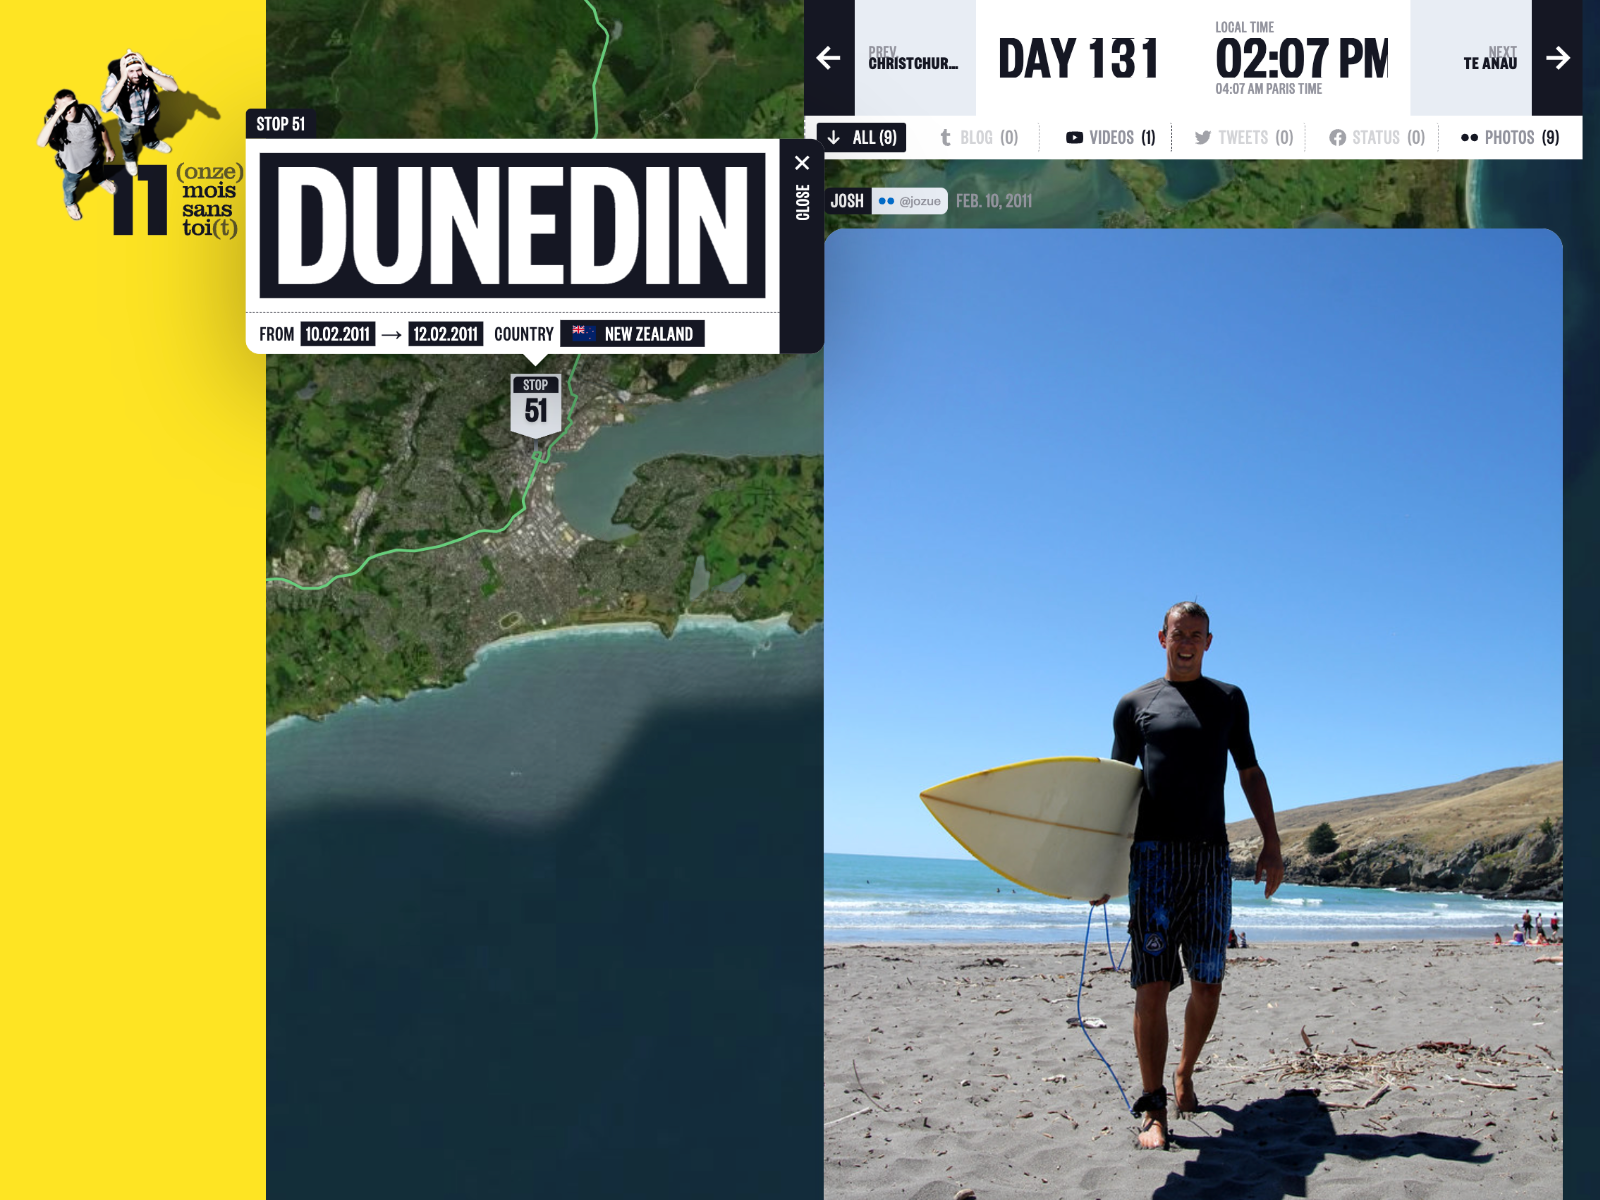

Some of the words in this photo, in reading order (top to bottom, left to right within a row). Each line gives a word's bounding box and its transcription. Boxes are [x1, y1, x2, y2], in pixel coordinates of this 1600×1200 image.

[1215, 20, 1247, 33] LOCAL
[1250, 20, 1275, 33] TIME
[999, 37, 1078, 78] DAY
[1089, 37, 1157, 78] 131
[1216, 37, 1330, 79] 02:07
[1339, 37, 1389, 79] PM
[1488, 45, 1518, 58] NEXT
[1463, 56, 1480, 70] TE
[1481, 56, 1518, 70] ANAU
[1215, 82, 1246, 95] 04:07
[1247, 82, 1264, 95] AM
[1266, 82, 1296, 95] PARIS
[1297, 82, 1323, 95] TIME
[256, 116, 289, 132] STOP
[291, 116, 305, 132] 51
[853, 130, 877, 146] ALL
[879, 129, 897, 147] (9)
[960, 130, 993, 146] BLOG
[1000, 129, 1019, 147] (0)
[1089, 130, 1134, 146] VIDEOS
[1141, 129, 1156, 147] (1)
[1218, 130, 1269, 146] TWEETS
[1275, 129, 1294, 147] (0)
[1352, 130, 1400, 146] STATUS
[1407, 129, 1426, 147] (0)
[1485, 130, 1535, 146] PHOTOS
[1541, 129, 1560, 147] (9)
[176, 162, 244, 184] (onze)
[183, 181, 236, 198] mois
[795, 184, 810, 221] CLOSE
[830, 193, 864, 209] JOSH
[899, 195, 942, 209] @jozue
[956, 193, 983, 209] FEB.
[985, 193, 1003, 210] 10,
[1005, 193, 1032, 209] 2011
[182, 203, 233, 217] sans
[183, 219, 238, 240] toi(t)
[277, 166, 748, 285] DUNEDIN
[259, 326, 295, 342] FROM
[305, 326, 370, 342] 10.02.2011
[413, 326, 478, 342] 12.02.2011
[494, 326, 555, 342] COUNTRY
[605, 326, 633, 342] NEW
[635, 326, 694, 342] ZEALAND
[522, 378, 549, 391] STOP
[524, 397, 547, 423] 51
